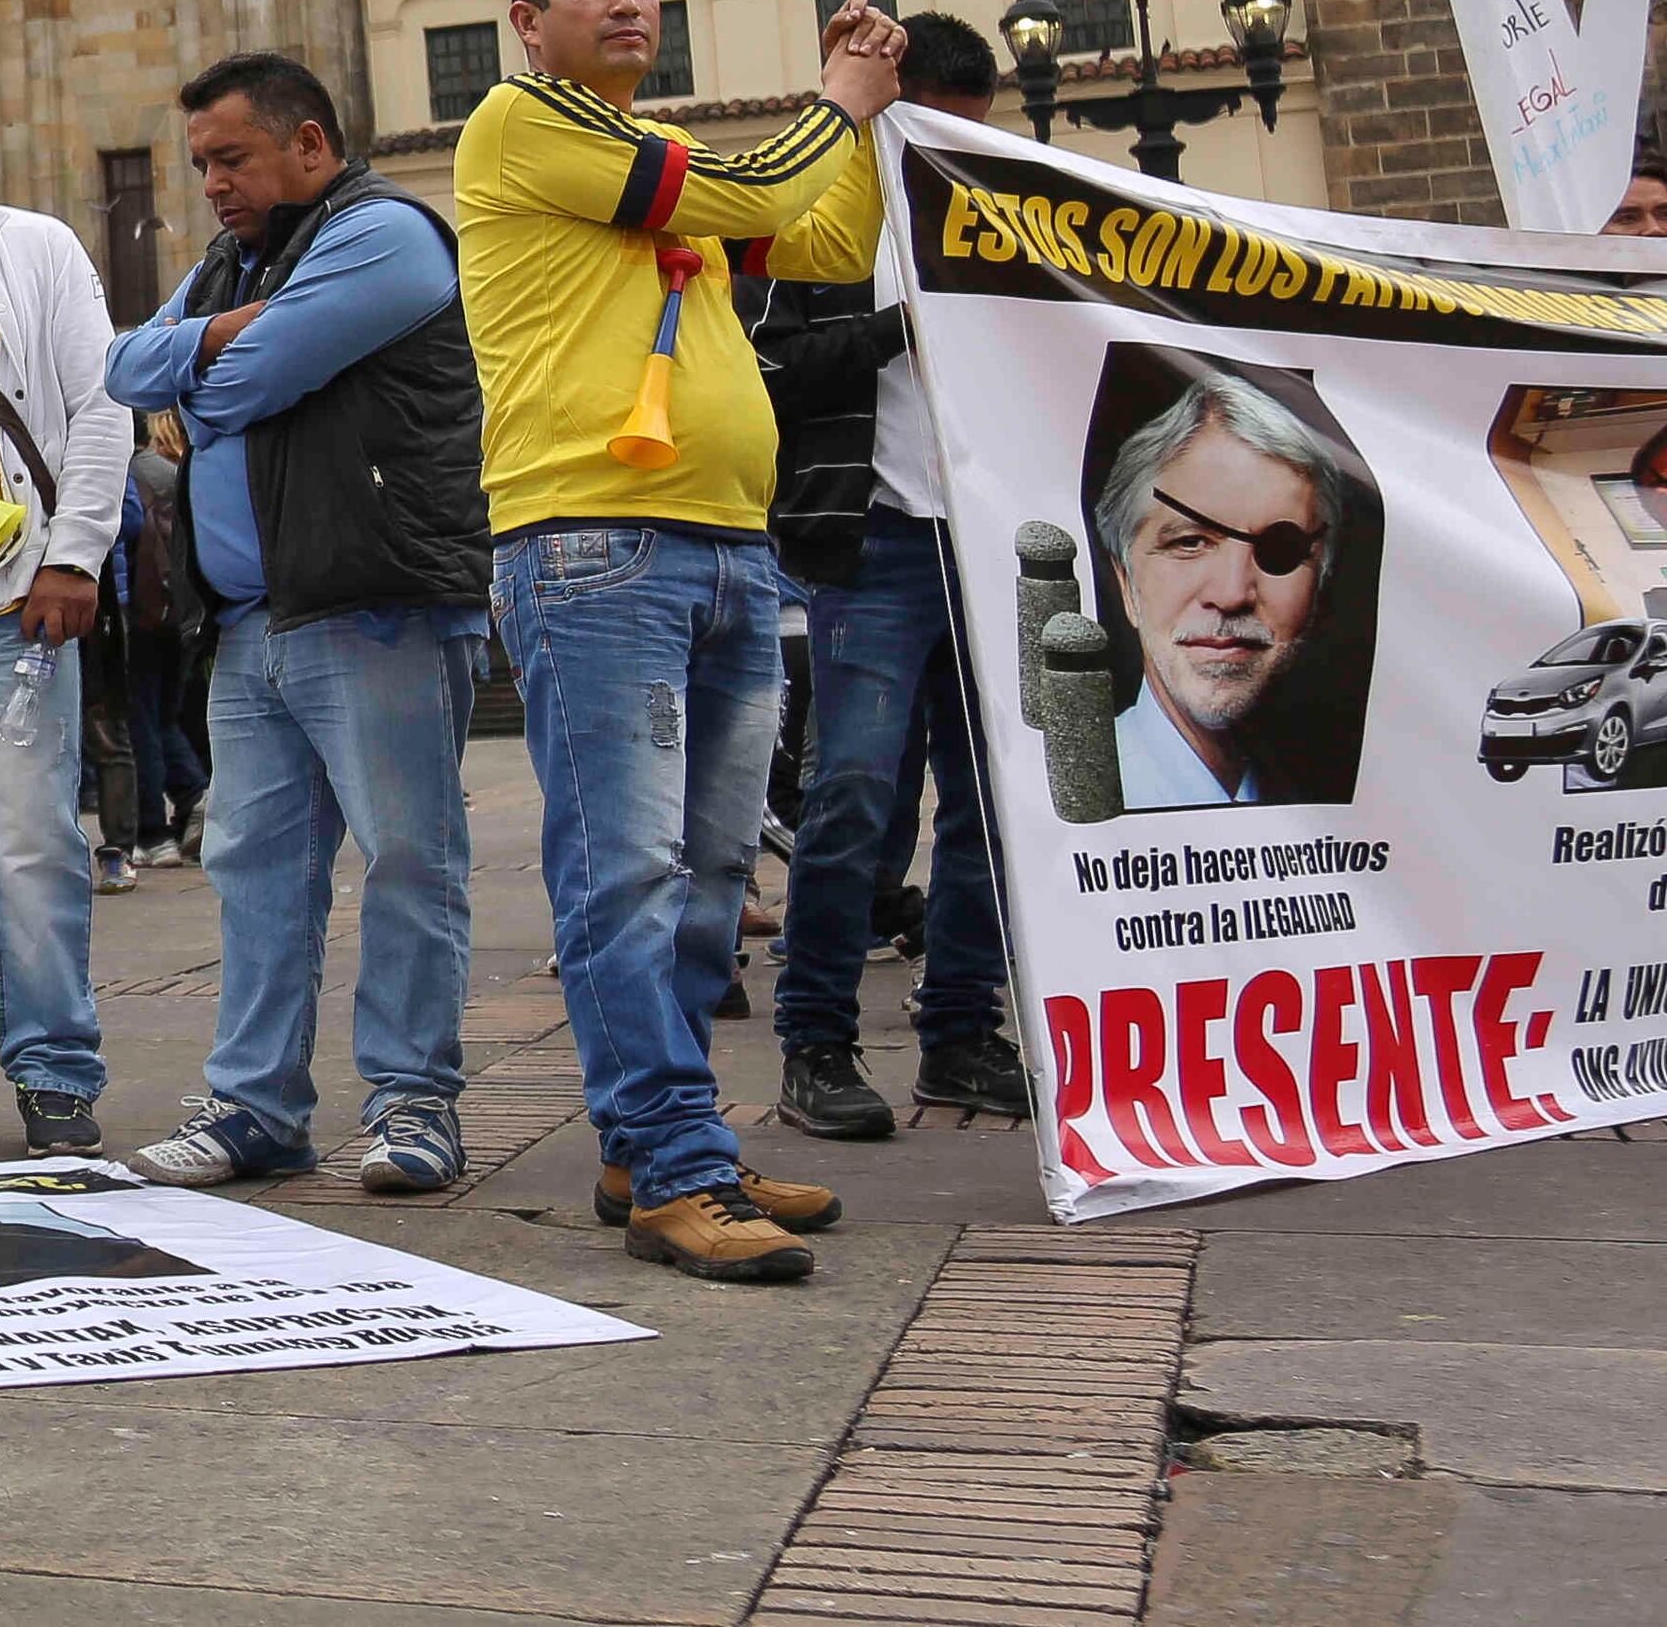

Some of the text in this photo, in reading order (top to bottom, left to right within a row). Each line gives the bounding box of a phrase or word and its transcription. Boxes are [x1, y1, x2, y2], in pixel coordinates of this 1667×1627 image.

[942, 179, 1091, 277] ESTOS
[1096, 206, 1211, 291] SON
[1206, 223, 1315, 299] LOS
[1072, 833, 1390, 894] No deja hacer operativos
[1552, 817, 1667, 864] Realizó
[1115, 891, 1357, 953] contra la ILEGALIDAD
[1042, 950, 1667, 1188] PRESENTE: LA UNI
[1571, 1037, 1667, 1103] ONG AYU
[211, 1282, 244, 1291] a
[35, 1344, 170, 1368] Taxis
